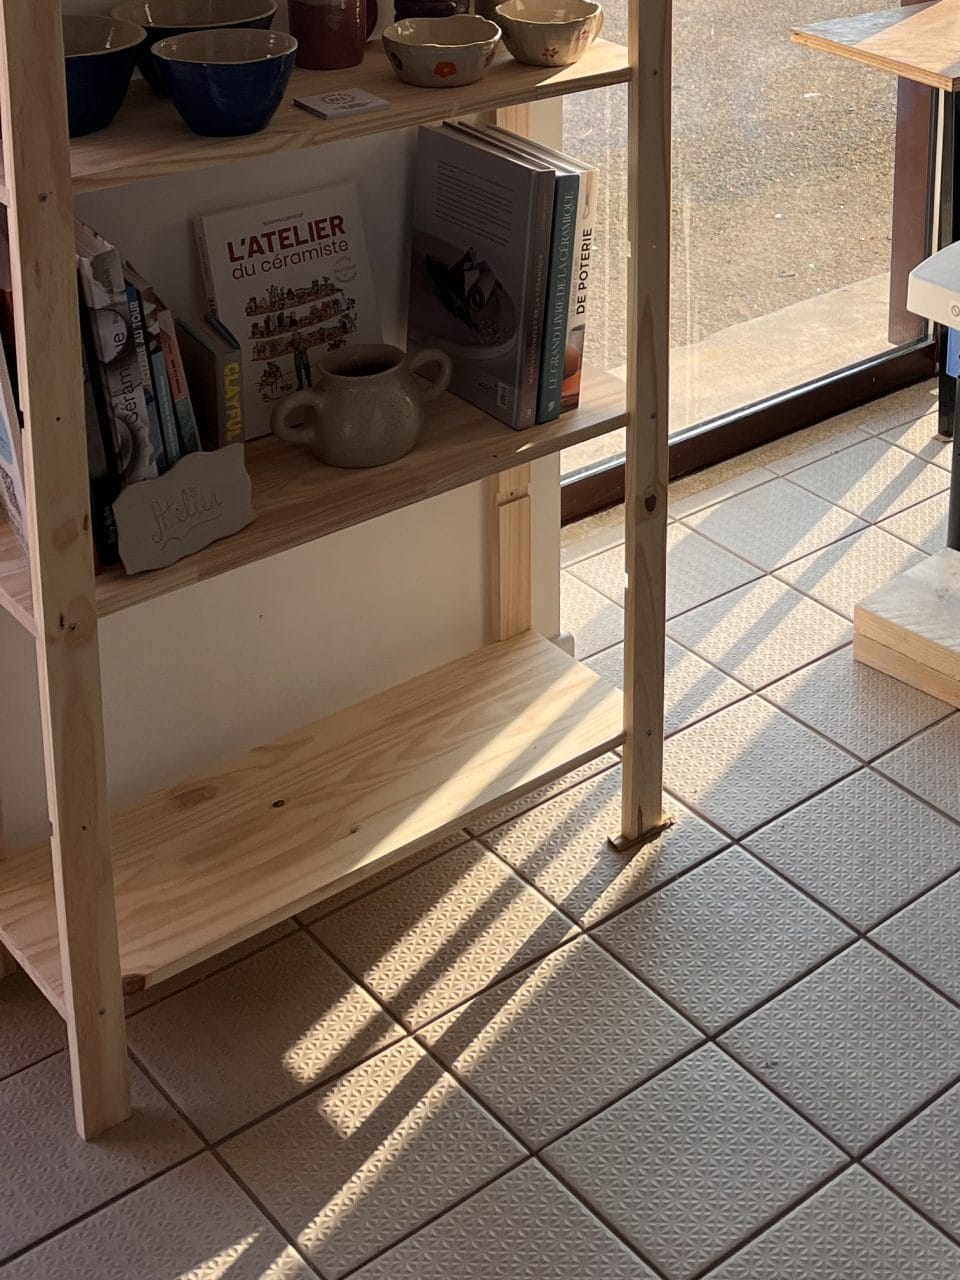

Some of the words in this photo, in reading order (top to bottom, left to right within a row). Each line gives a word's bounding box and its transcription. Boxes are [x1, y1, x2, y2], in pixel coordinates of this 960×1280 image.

[227, 214, 347, 263] L'ATELIER
[559, 191, 575, 261] CÉRAMIQUE
[232, 260, 256, 280] du
[260, 239, 349, 273] céramiste
[557, 261, 568, 277] LA
[578, 228, 592, 290] POTERIE
[556, 278, 567, 295] DE
[129, 300, 143, 328] TOUR
[553, 297, 565, 330] LIVRE
[576, 296, 586, 314] DE
[133, 328, 145, 344] AU
[550, 331, 562, 373] GRAND
[548, 375, 558, 389] LE
[223, 362, 242, 441] CLAYFUL
